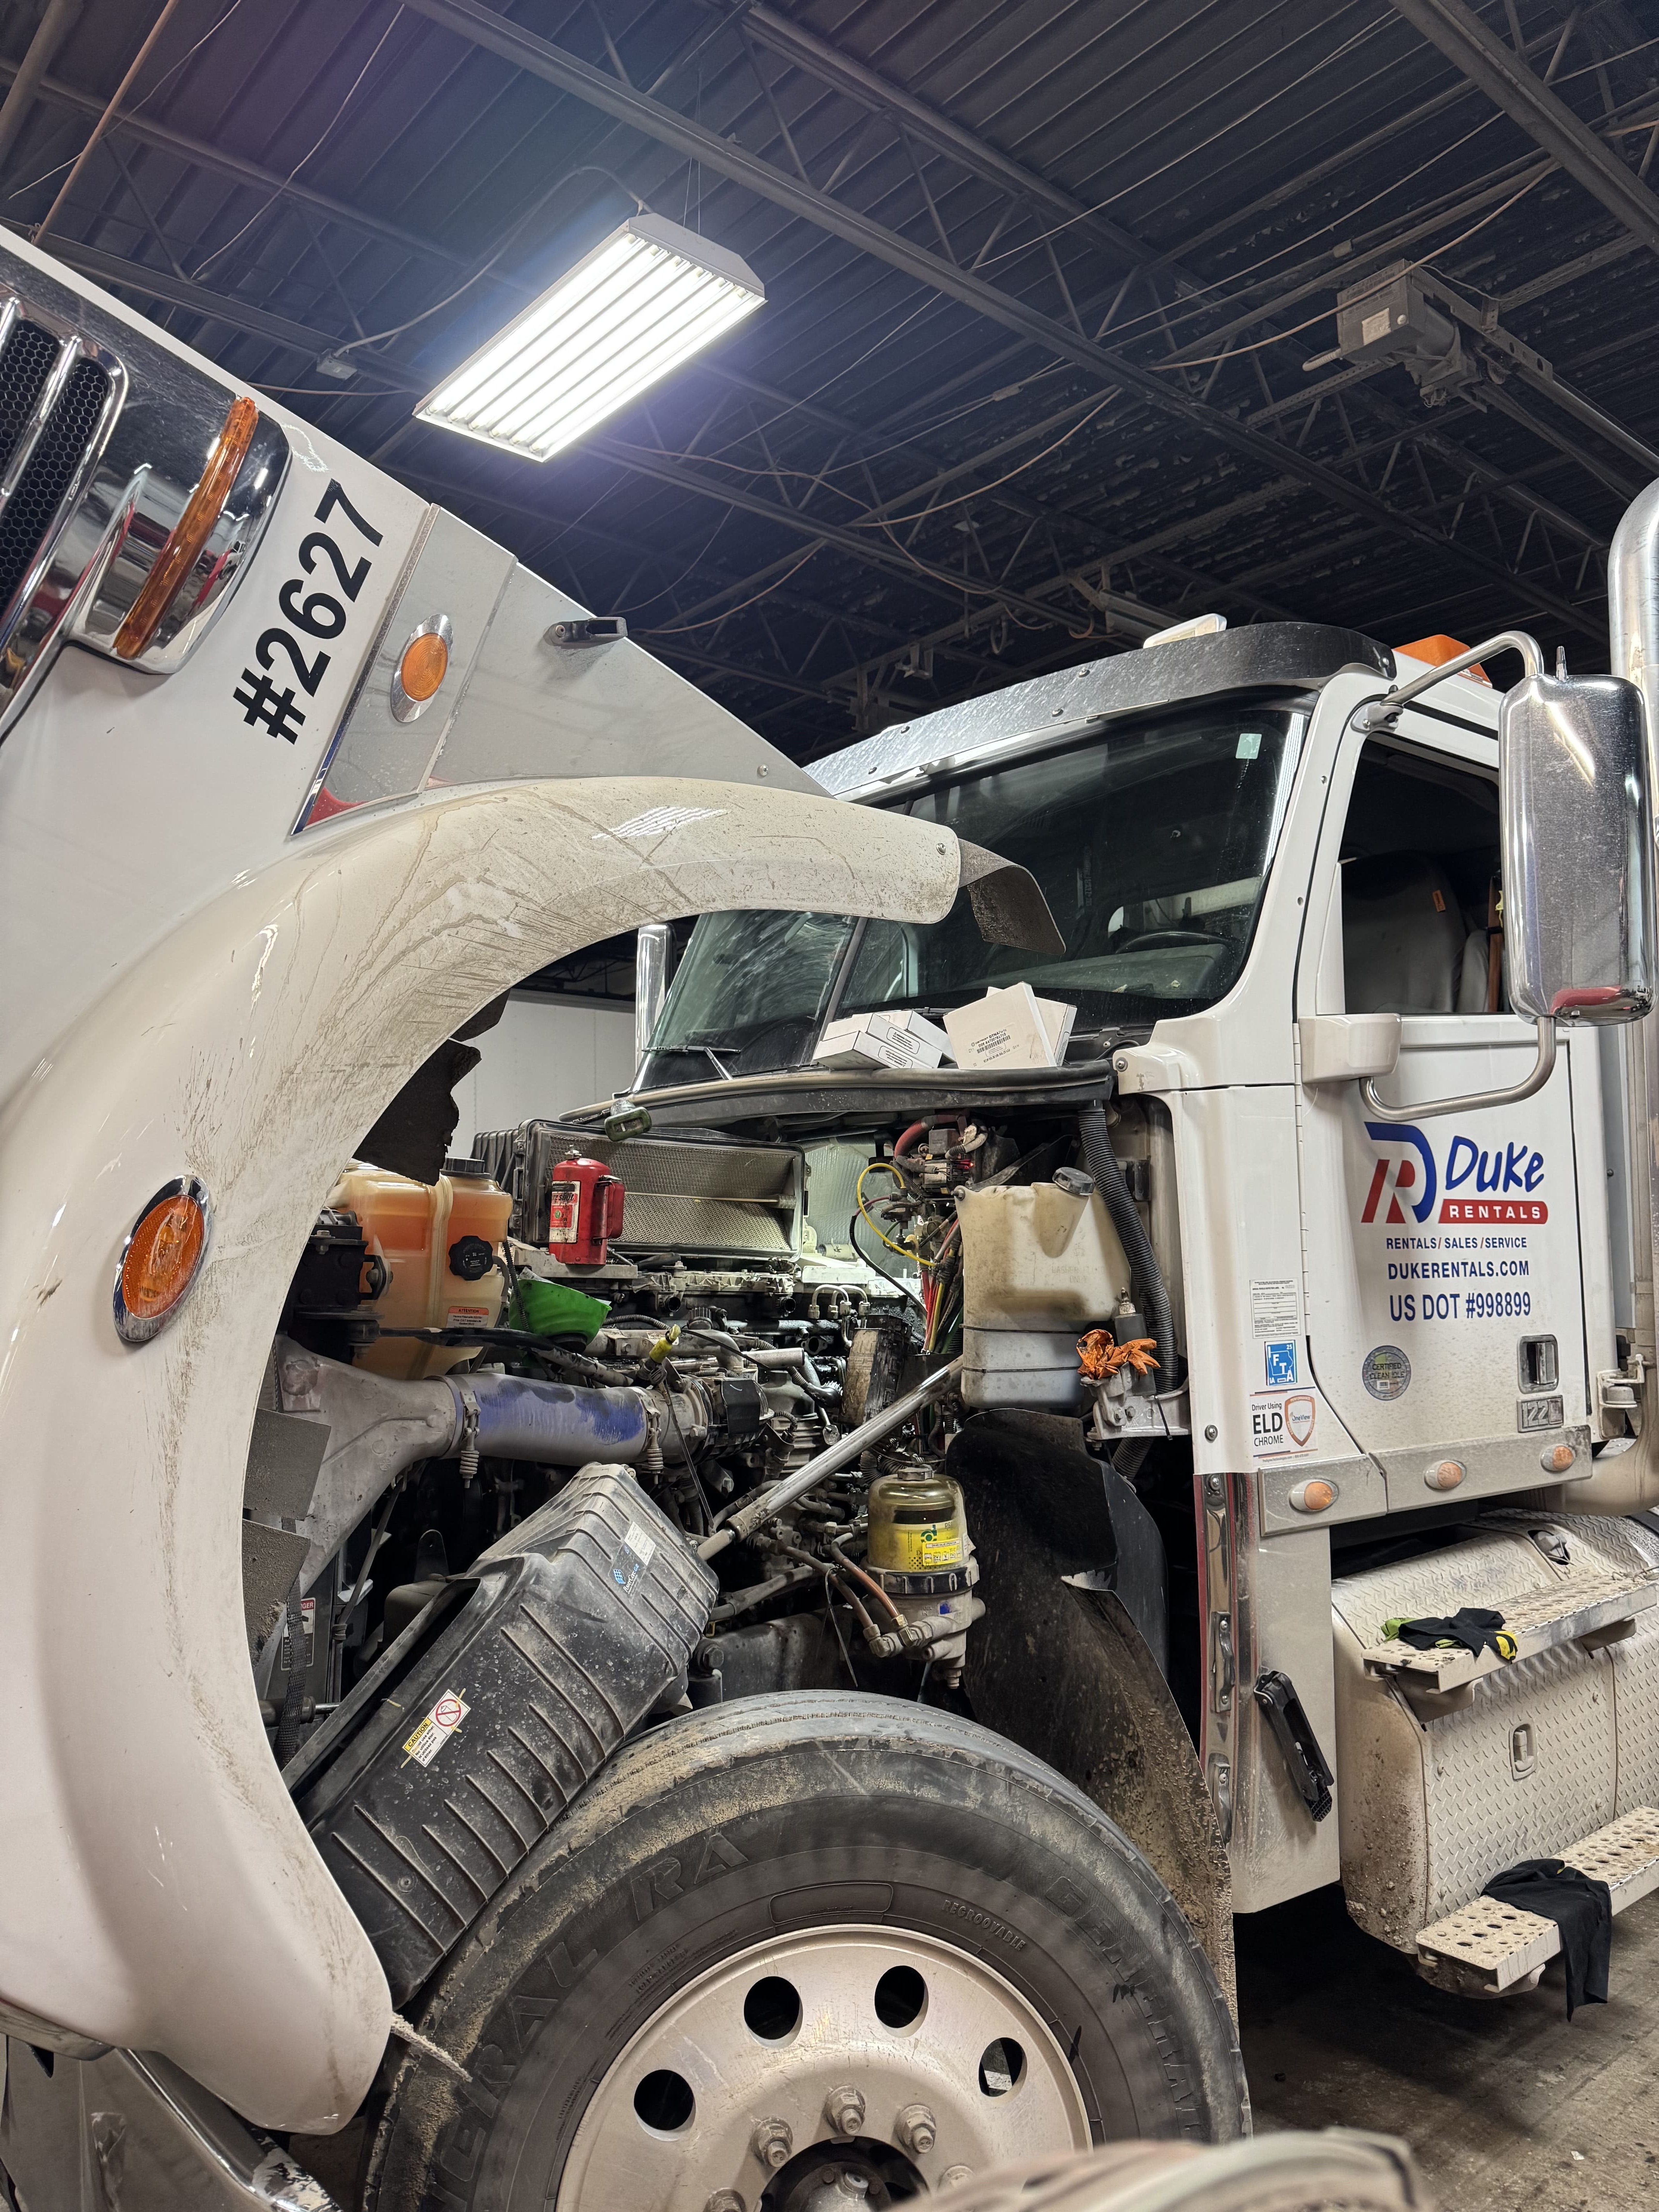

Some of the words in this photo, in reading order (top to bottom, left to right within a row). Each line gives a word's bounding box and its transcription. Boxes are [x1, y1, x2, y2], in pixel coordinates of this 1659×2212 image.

[233, 478, 384, 745] #2627
[1449, 1205, 1540, 1218] RENTALS
[1388, 1261, 1529, 1280] DUKERENTALS.COM
[1389, 1294, 1416, 1321] US
[1422, 1293, 1460, 1320] DOT
[1466, 1291, 1531, 1319] #998899
[1267, 1401, 1282, 1410] Using
[1522, 1400, 1549, 1427] 122
[1253, 1412, 1283, 1434] ELD
[1254, 1435, 1284, 1446] CHROME
[408, 1723, 428, 1747] CAUTION
[631, 1832, 749, 1921] RA
[941, 1898, 1028, 1952] REGROOVABLE
